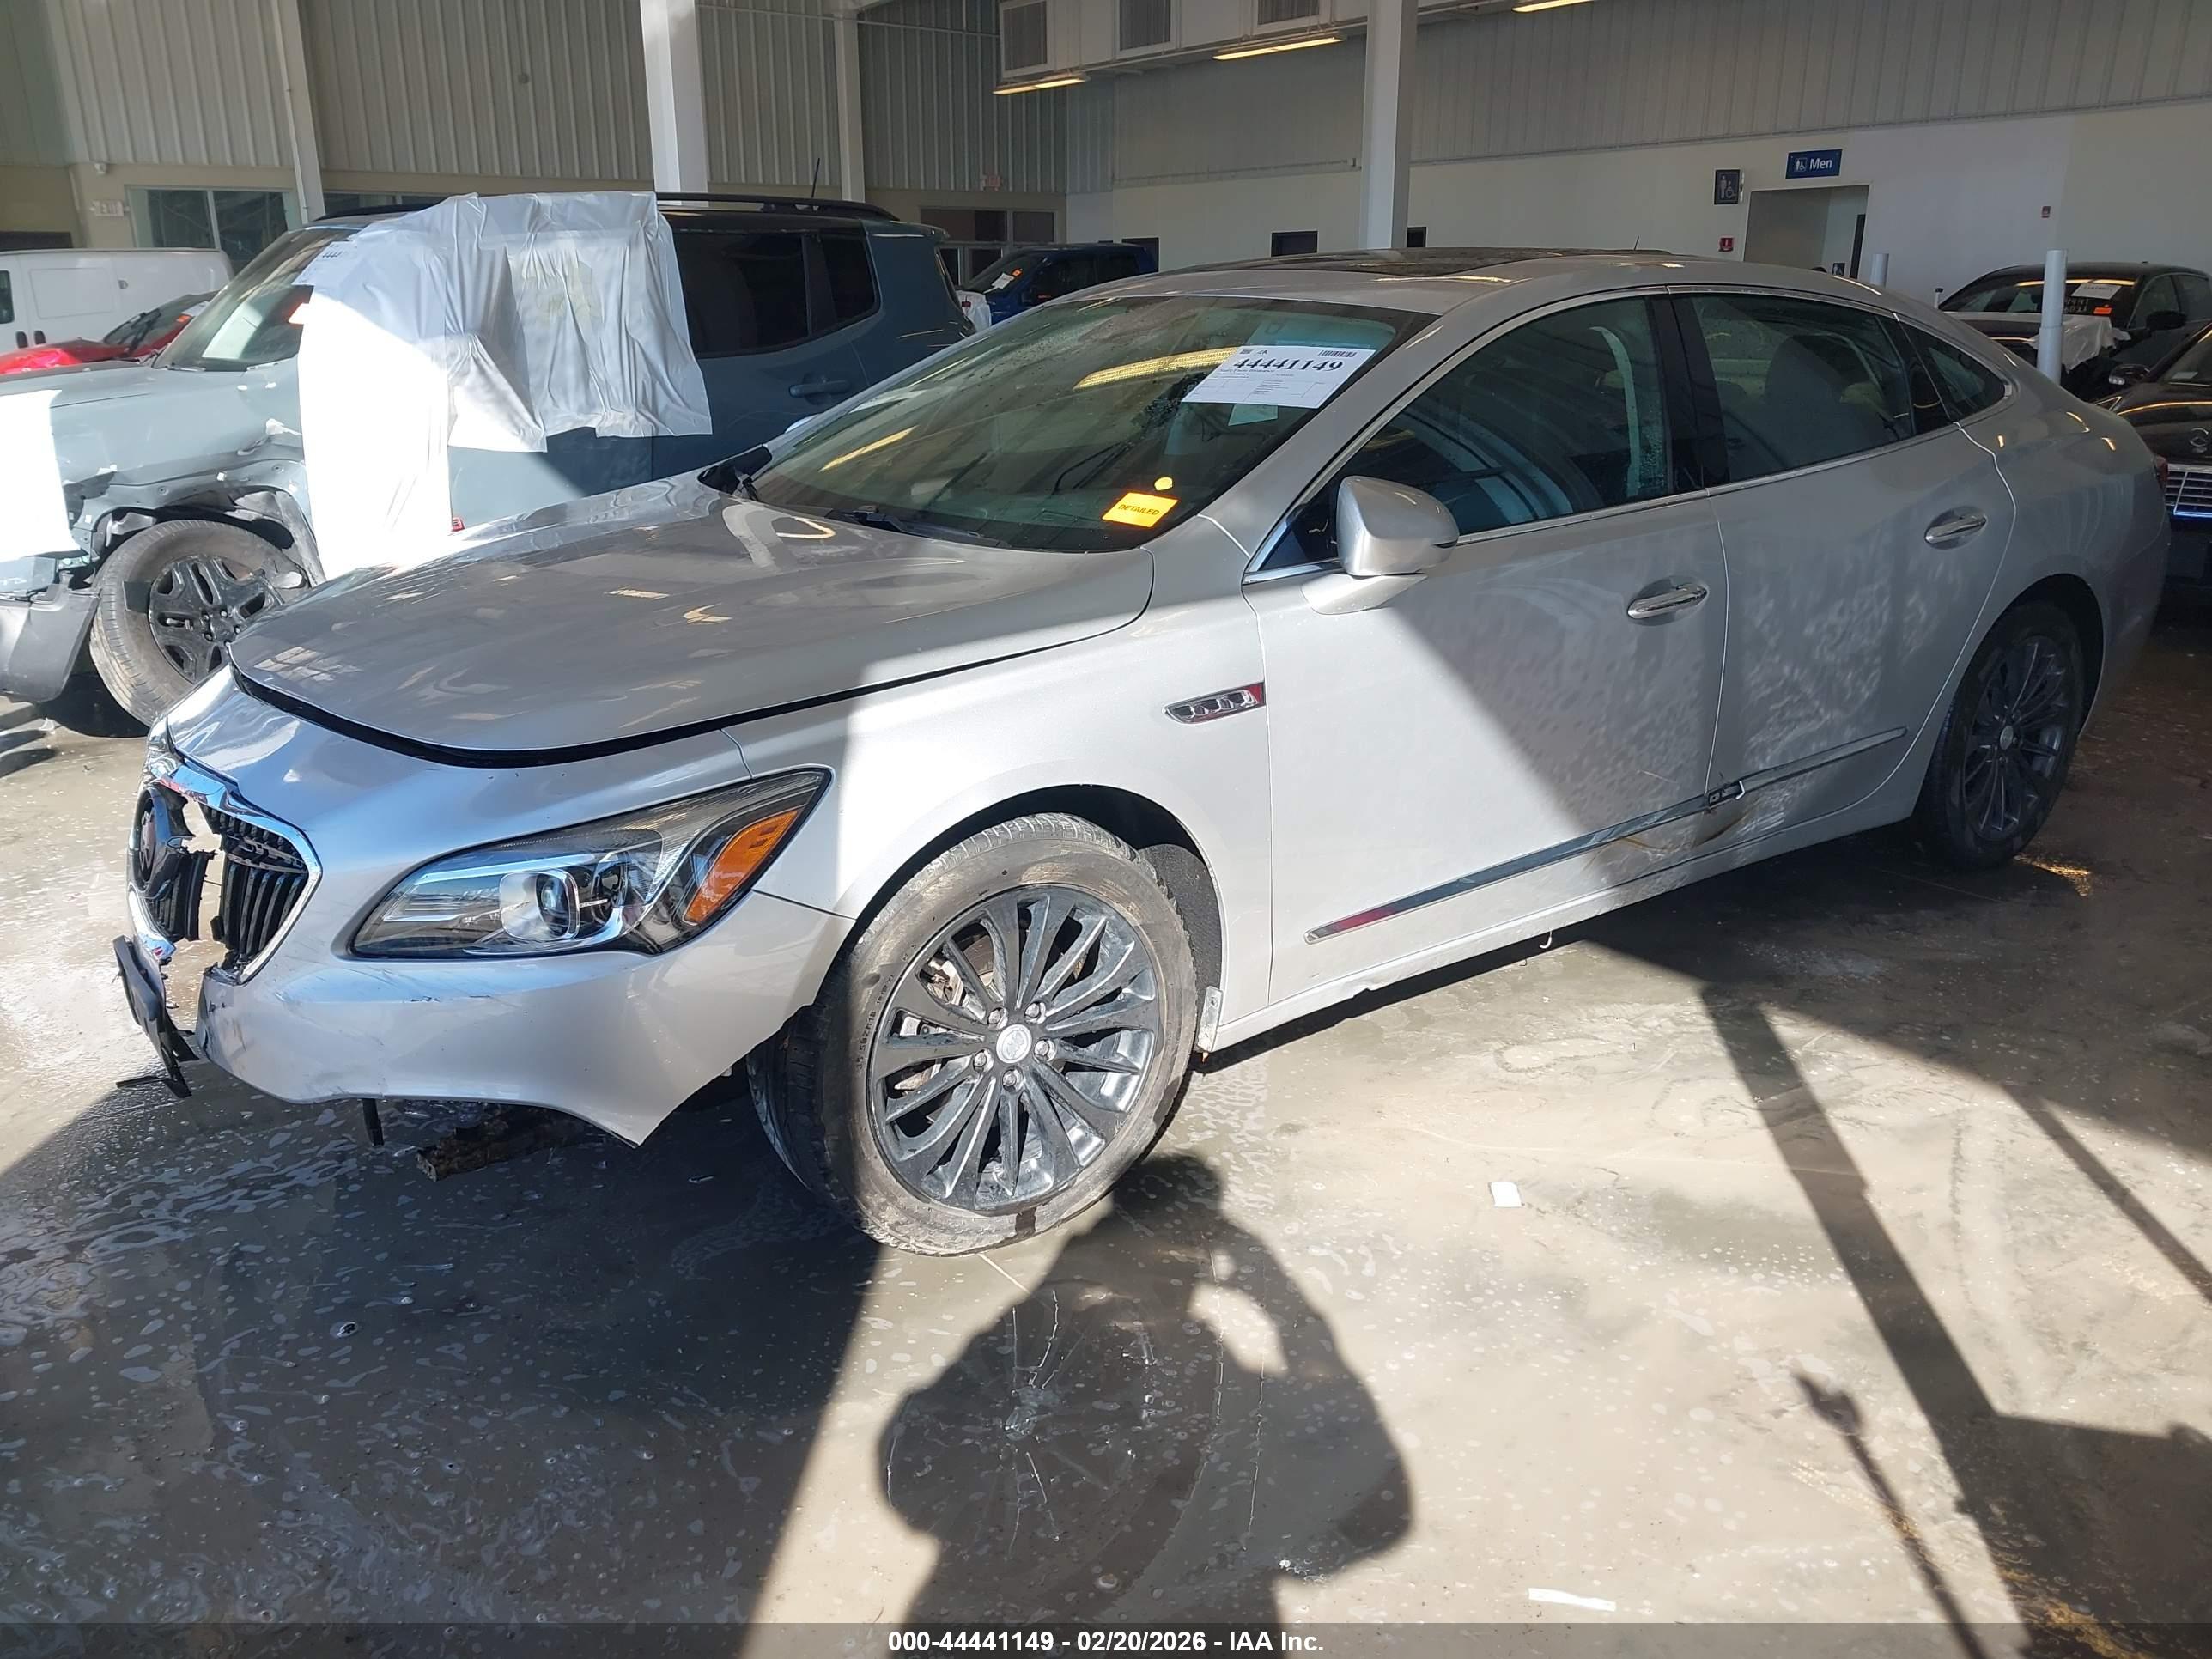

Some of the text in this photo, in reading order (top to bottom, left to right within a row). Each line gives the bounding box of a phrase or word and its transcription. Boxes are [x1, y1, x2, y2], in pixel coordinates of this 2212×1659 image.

[1809, 158, 1832, 170] Men
[1234, 357, 1344, 372] 44441149
[1118, 504, 1160, 516] DETAILED
